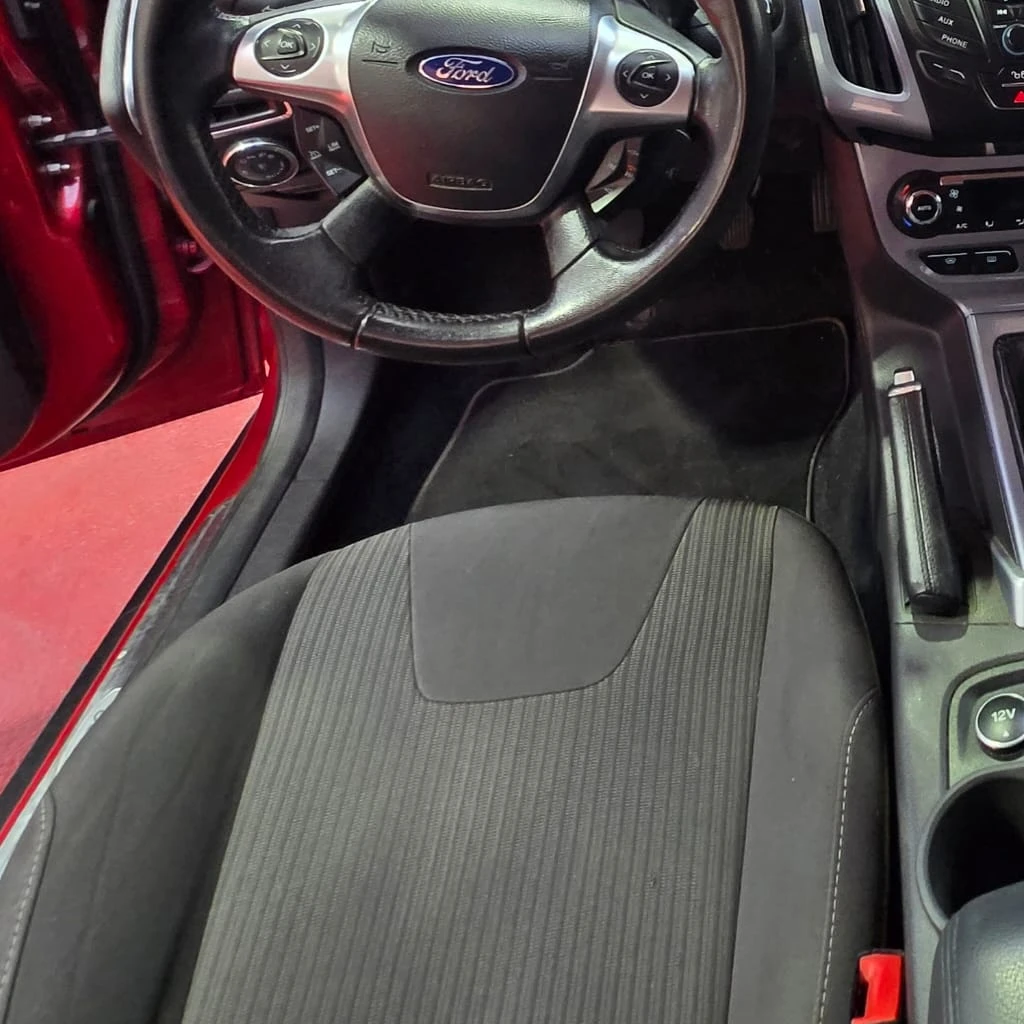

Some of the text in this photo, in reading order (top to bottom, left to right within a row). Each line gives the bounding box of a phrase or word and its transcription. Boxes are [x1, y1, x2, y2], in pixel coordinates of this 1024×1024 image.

[938, 16, 954, 26] AUX
[280, 40, 294, 49] OK
[941, 34, 968, 49] PHONE
[435, 57, 496, 83] Ford
[642, 72, 655, 80] OK
[991, 708, 1016, 722] 12V
